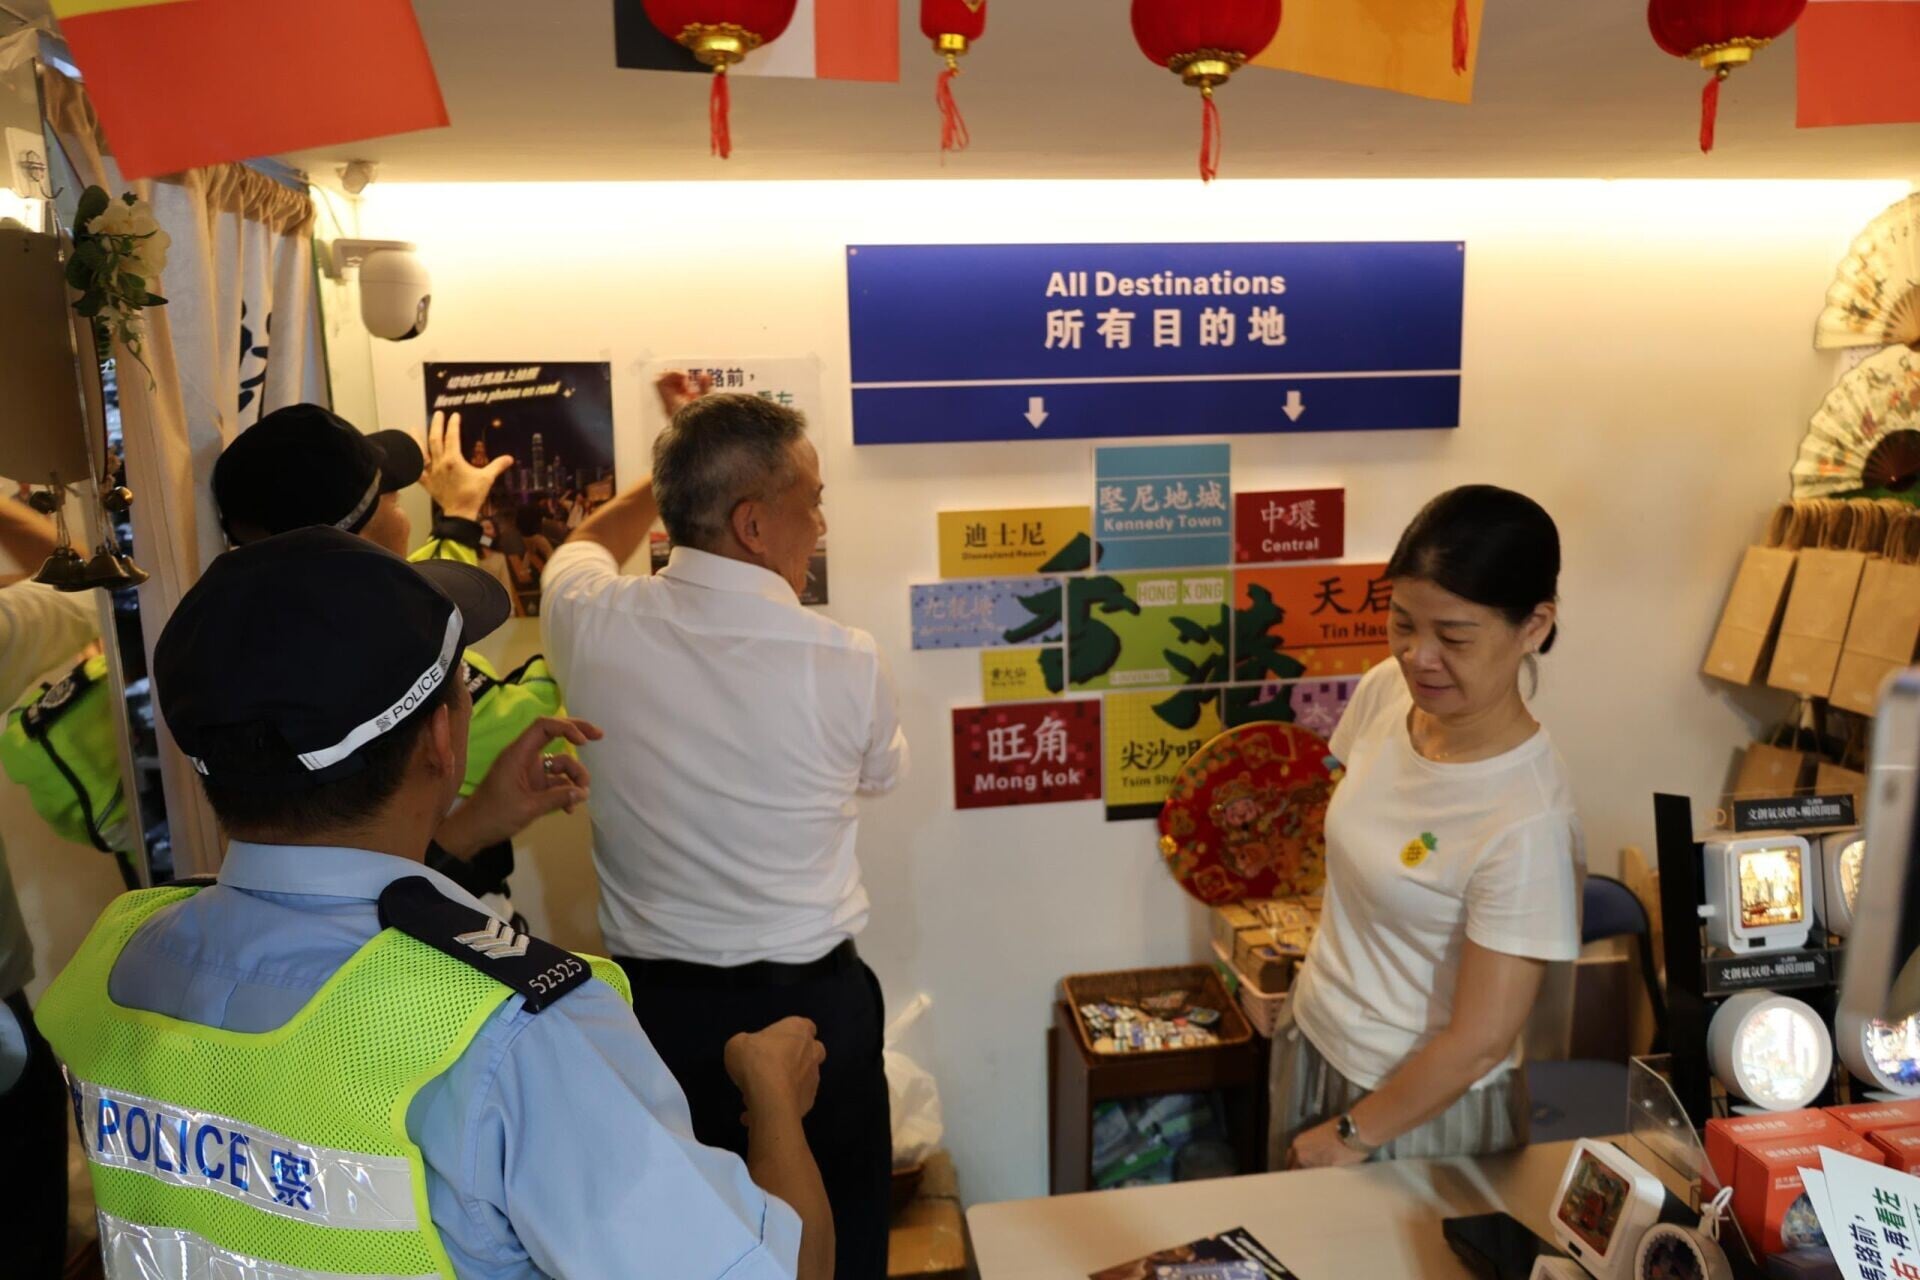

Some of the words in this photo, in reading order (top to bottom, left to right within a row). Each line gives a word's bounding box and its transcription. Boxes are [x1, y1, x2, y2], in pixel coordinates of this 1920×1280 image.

[1046, 271, 1087, 296] All
[1096, 270, 1286, 296] Destinations
[1045, 306, 1287, 348] 所有目的地
[1099, 480, 1226, 514] 堅尼地城
[1103, 515, 1174, 532] Kennedy
[1177, 514, 1223, 529] Town
[1260, 499, 1320, 534] 中環
[964, 521, 1045, 548] 迪士尼
[1261, 537, 1320, 553] Central
[1138, 584, 1177, 603] HONG
[1311, 576, 1393, 615] 天后
[1320, 624, 1349, 639] Tin
[1354, 622, 1388, 638] Hau
[391, 666, 442, 719] POLICE
[987, 715, 1068, 764] 旺角
[975, 773, 1038, 793] Mong
[1042, 767, 1081, 787] kok
[1122, 776, 1152, 787] Tsim
[528, 958, 582, 994] 52325
[97, 1096, 250, 1192] POLICE
[270, 1147, 311, 1210] 察
